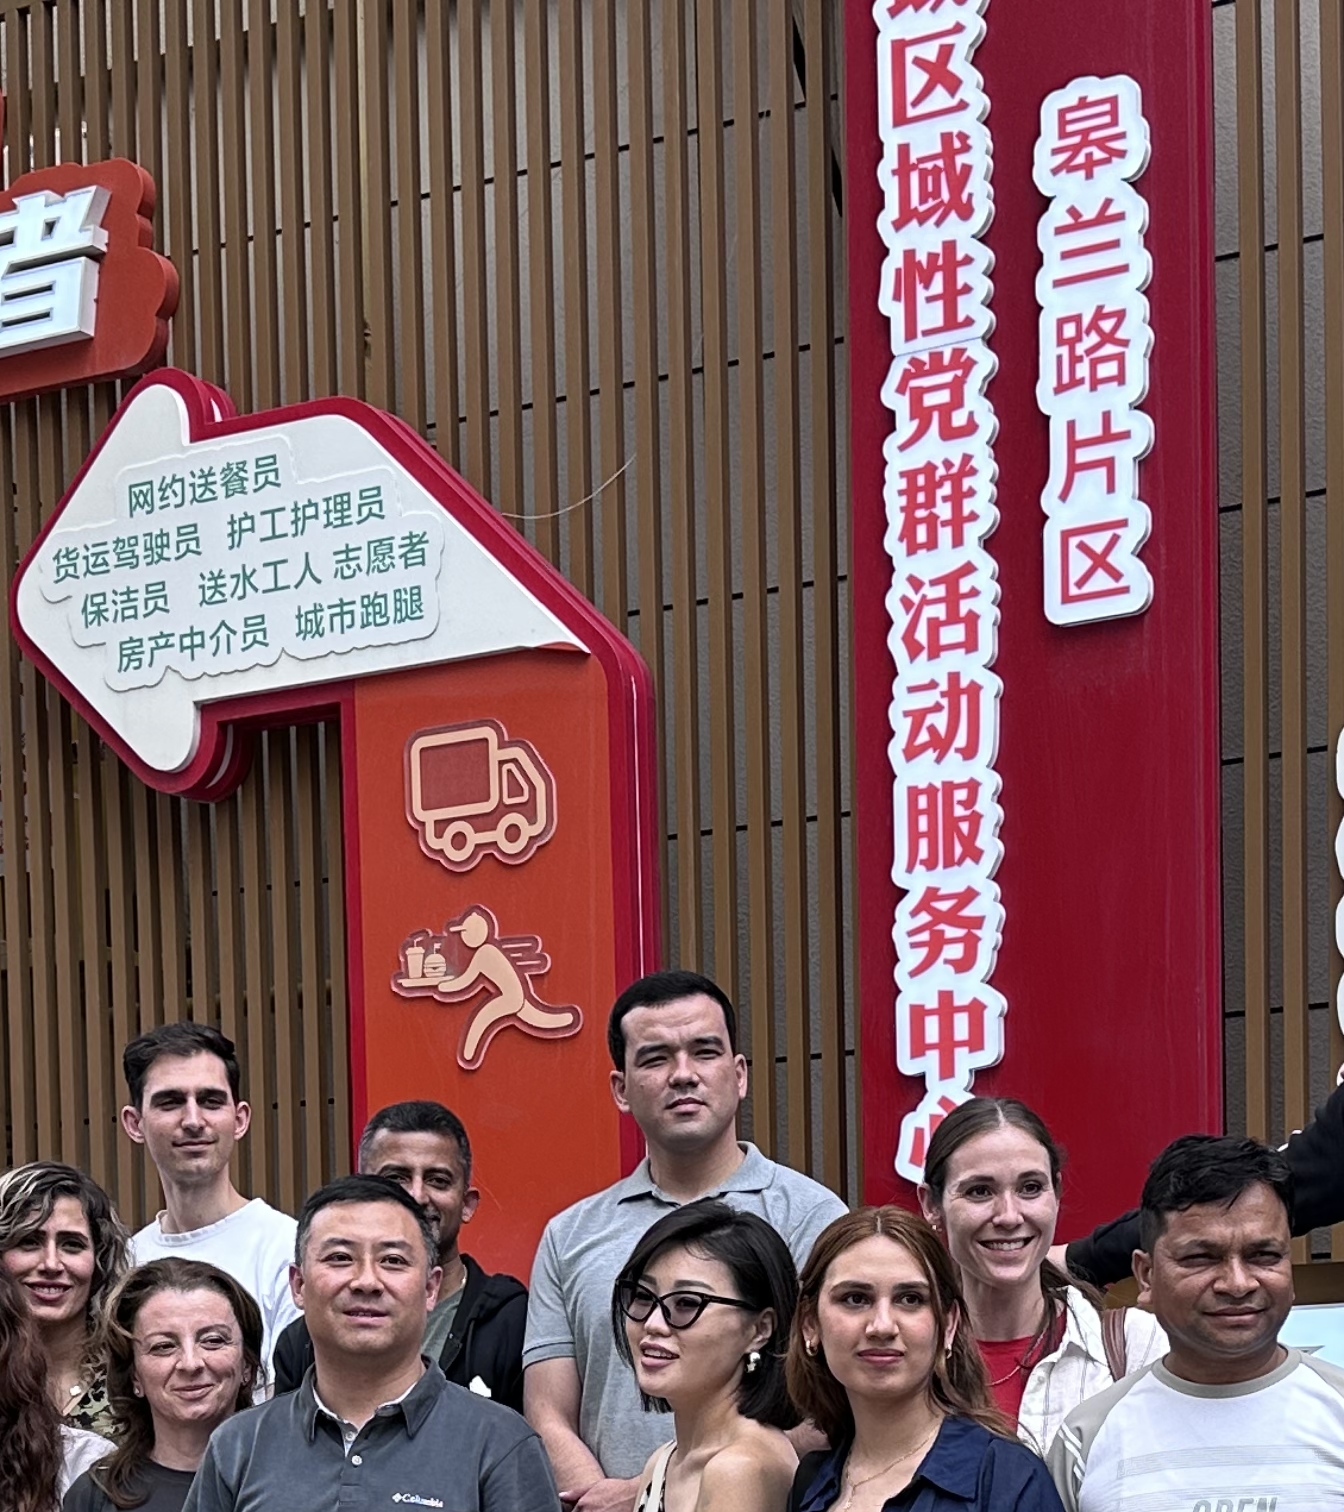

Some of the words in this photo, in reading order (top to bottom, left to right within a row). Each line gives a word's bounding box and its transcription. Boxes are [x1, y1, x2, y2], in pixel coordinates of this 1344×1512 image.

[1050, 94, 1131, 605] 皋兰路片区
[51, 522, 203, 584] 货运驾驶员
[226, 485, 387, 551] 护工护理员
[128, 453, 282, 518] 网约送餐员
[81, 581, 171, 629] 保洁员
[198, 551, 323, 609] 送水工人
[332, 531, 431, 582] 志愿者
[887, 0, 988, 1168] 区域性党群活动服务中
[117, 614, 270, 674] 房产中介员
[295, 585, 425, 642] 城市跑腿
